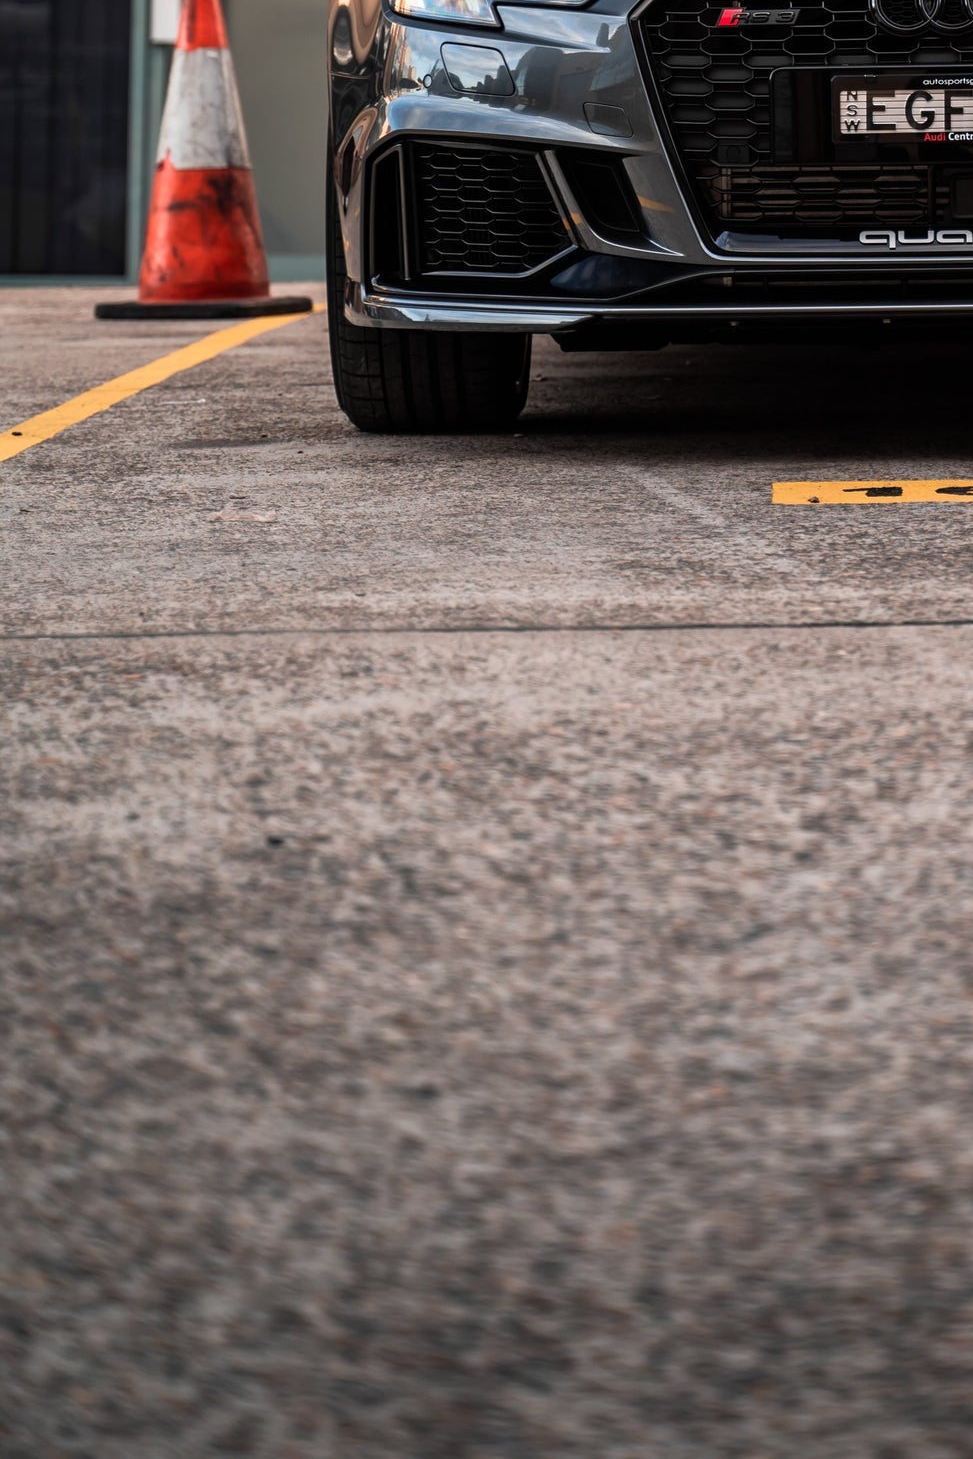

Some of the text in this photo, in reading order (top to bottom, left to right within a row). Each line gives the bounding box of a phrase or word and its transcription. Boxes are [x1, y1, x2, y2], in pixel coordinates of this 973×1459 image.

[730, 10, 795, 24] RS 3
[924, 132, 946, 141] Audi
